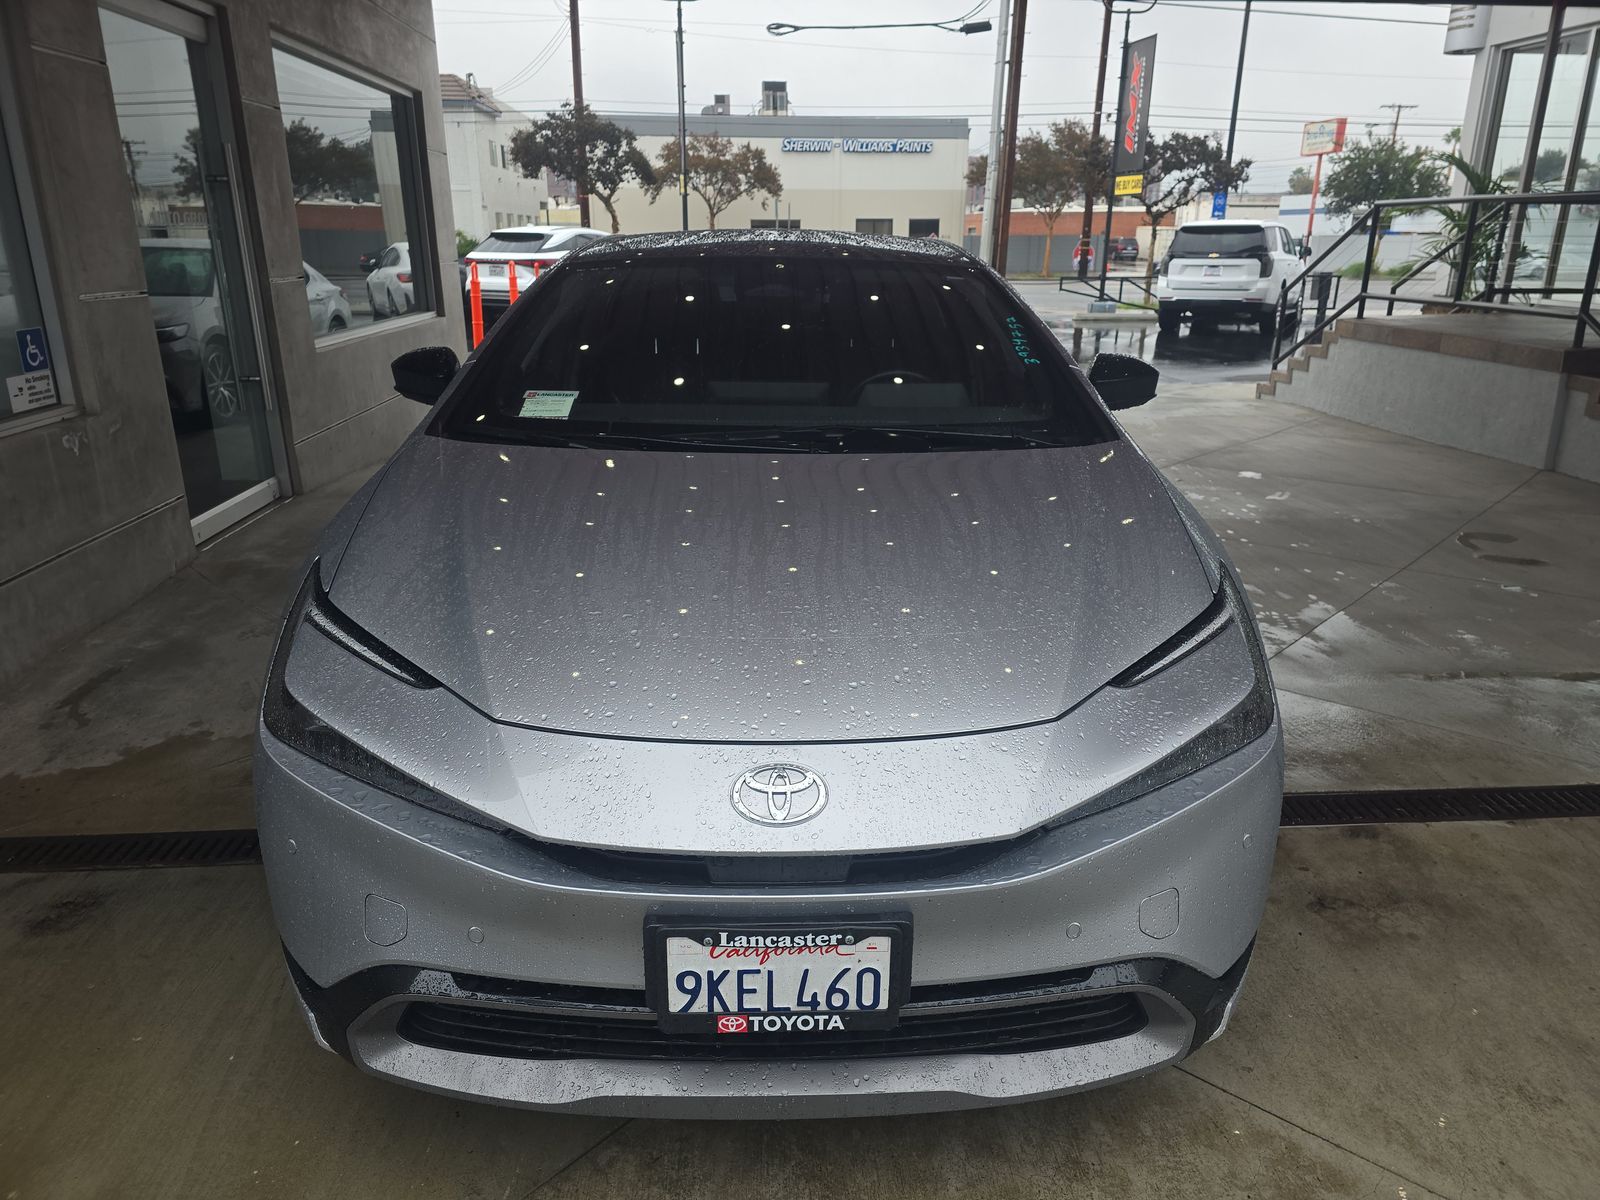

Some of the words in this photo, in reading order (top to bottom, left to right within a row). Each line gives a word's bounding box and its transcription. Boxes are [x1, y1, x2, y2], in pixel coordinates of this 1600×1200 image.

[782, 138, 832, 152] SHERWIN
[843, 138, 895, 153] WILLIAMS
[896, 138, 933, 153] PAINTS
[719, 932, 842, 947] Lancaster
[675, 967, 881, 1013] 9KEL460
[749, 1015, 845, 1031] TOYOTA
